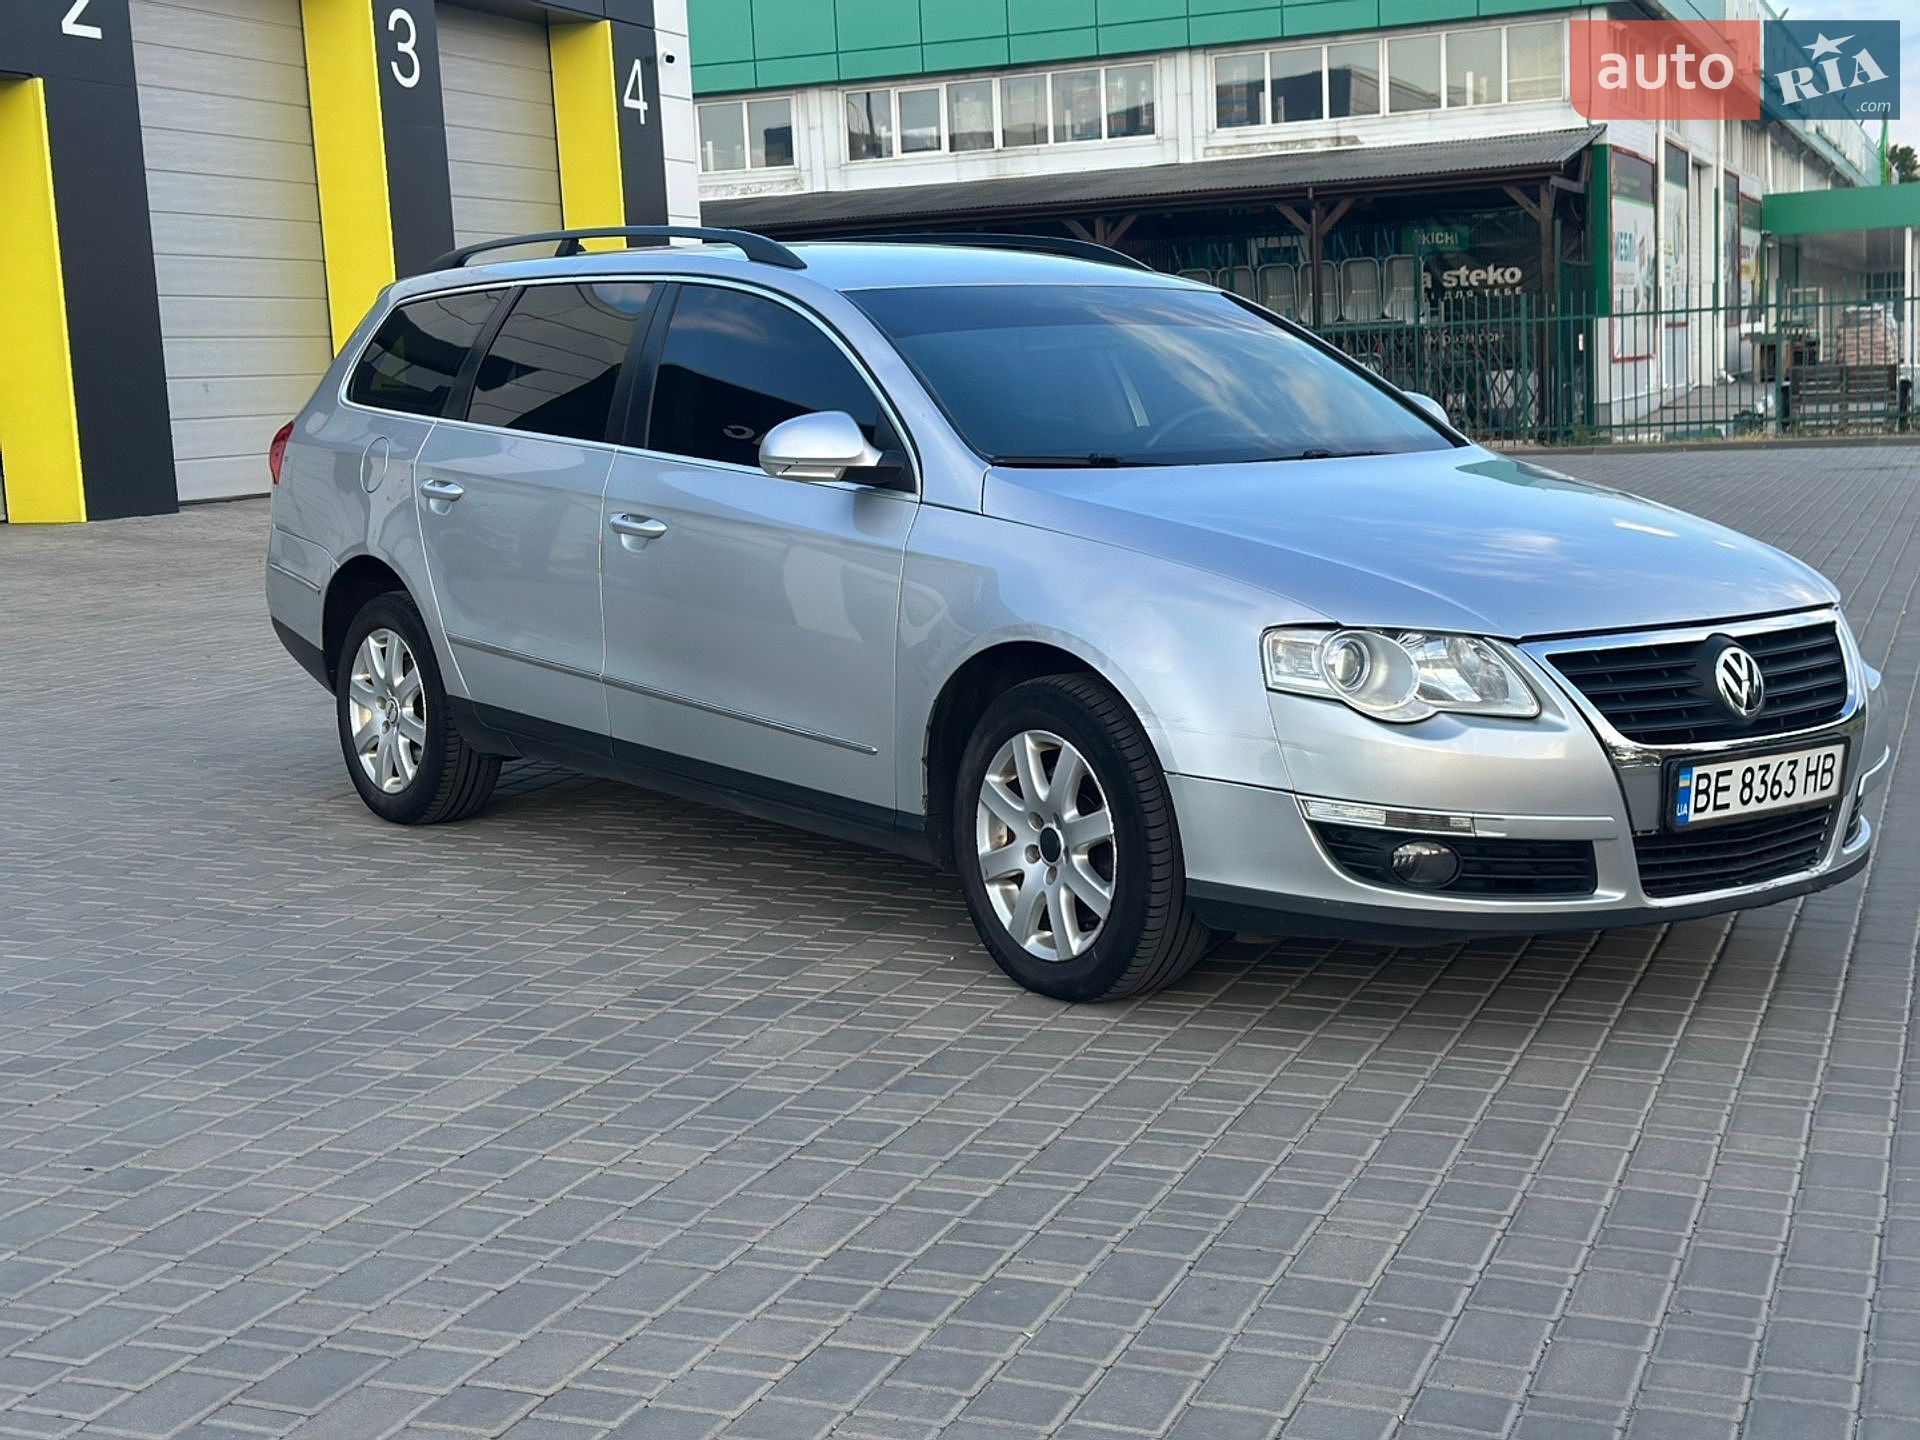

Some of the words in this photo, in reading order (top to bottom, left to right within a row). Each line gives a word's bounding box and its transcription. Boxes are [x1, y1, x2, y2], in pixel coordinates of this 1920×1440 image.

[388, 8, 421, 88] 3
[623, 58, 648, 125] 4
[1441, 263, 1523, 288] steko
[1676, 803, 1688, 816] UA
[1693, 769, 1733, 813] BE
[1739, 759, 1799, 806] 8363
[1804, 753, 1836, 796] HB
